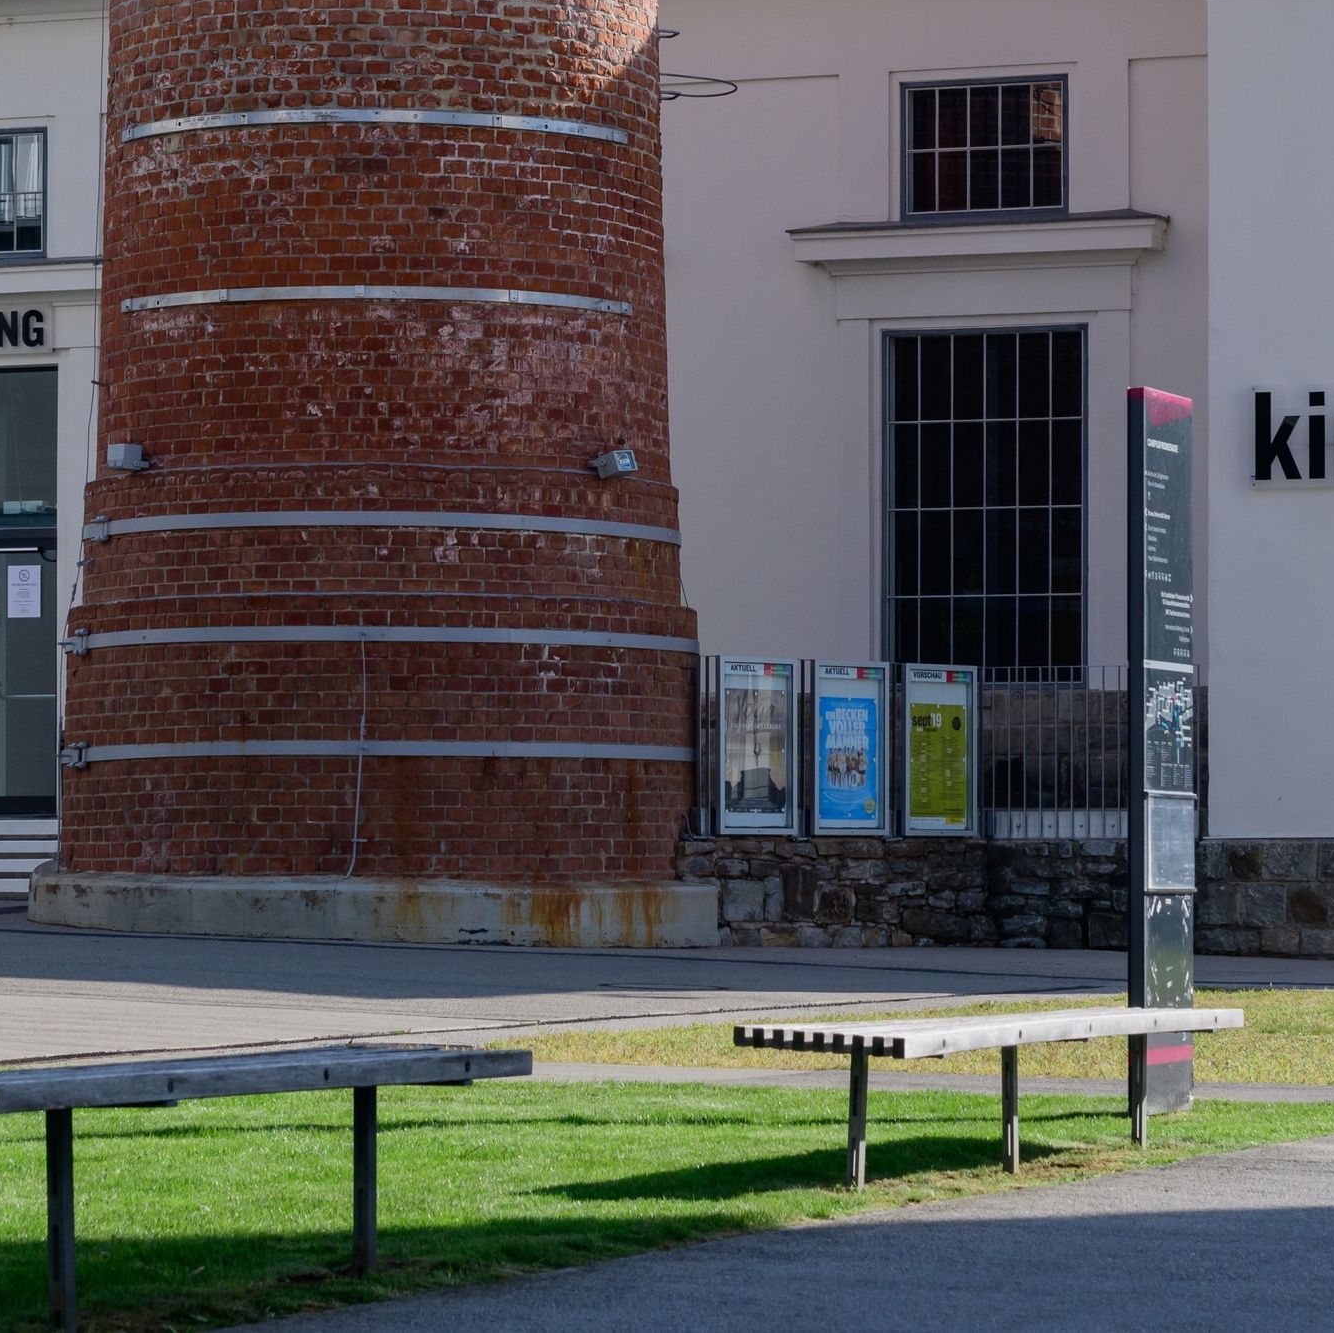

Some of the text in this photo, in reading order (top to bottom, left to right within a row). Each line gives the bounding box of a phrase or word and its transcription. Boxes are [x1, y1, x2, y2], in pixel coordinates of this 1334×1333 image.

[730, 664, 756, 672] AKTUELL
[913, 671, 943, 679] VORSCHAU
[835, 708, 868, 722] BECKEN
[828, 720, 866, 735] VOLLER
